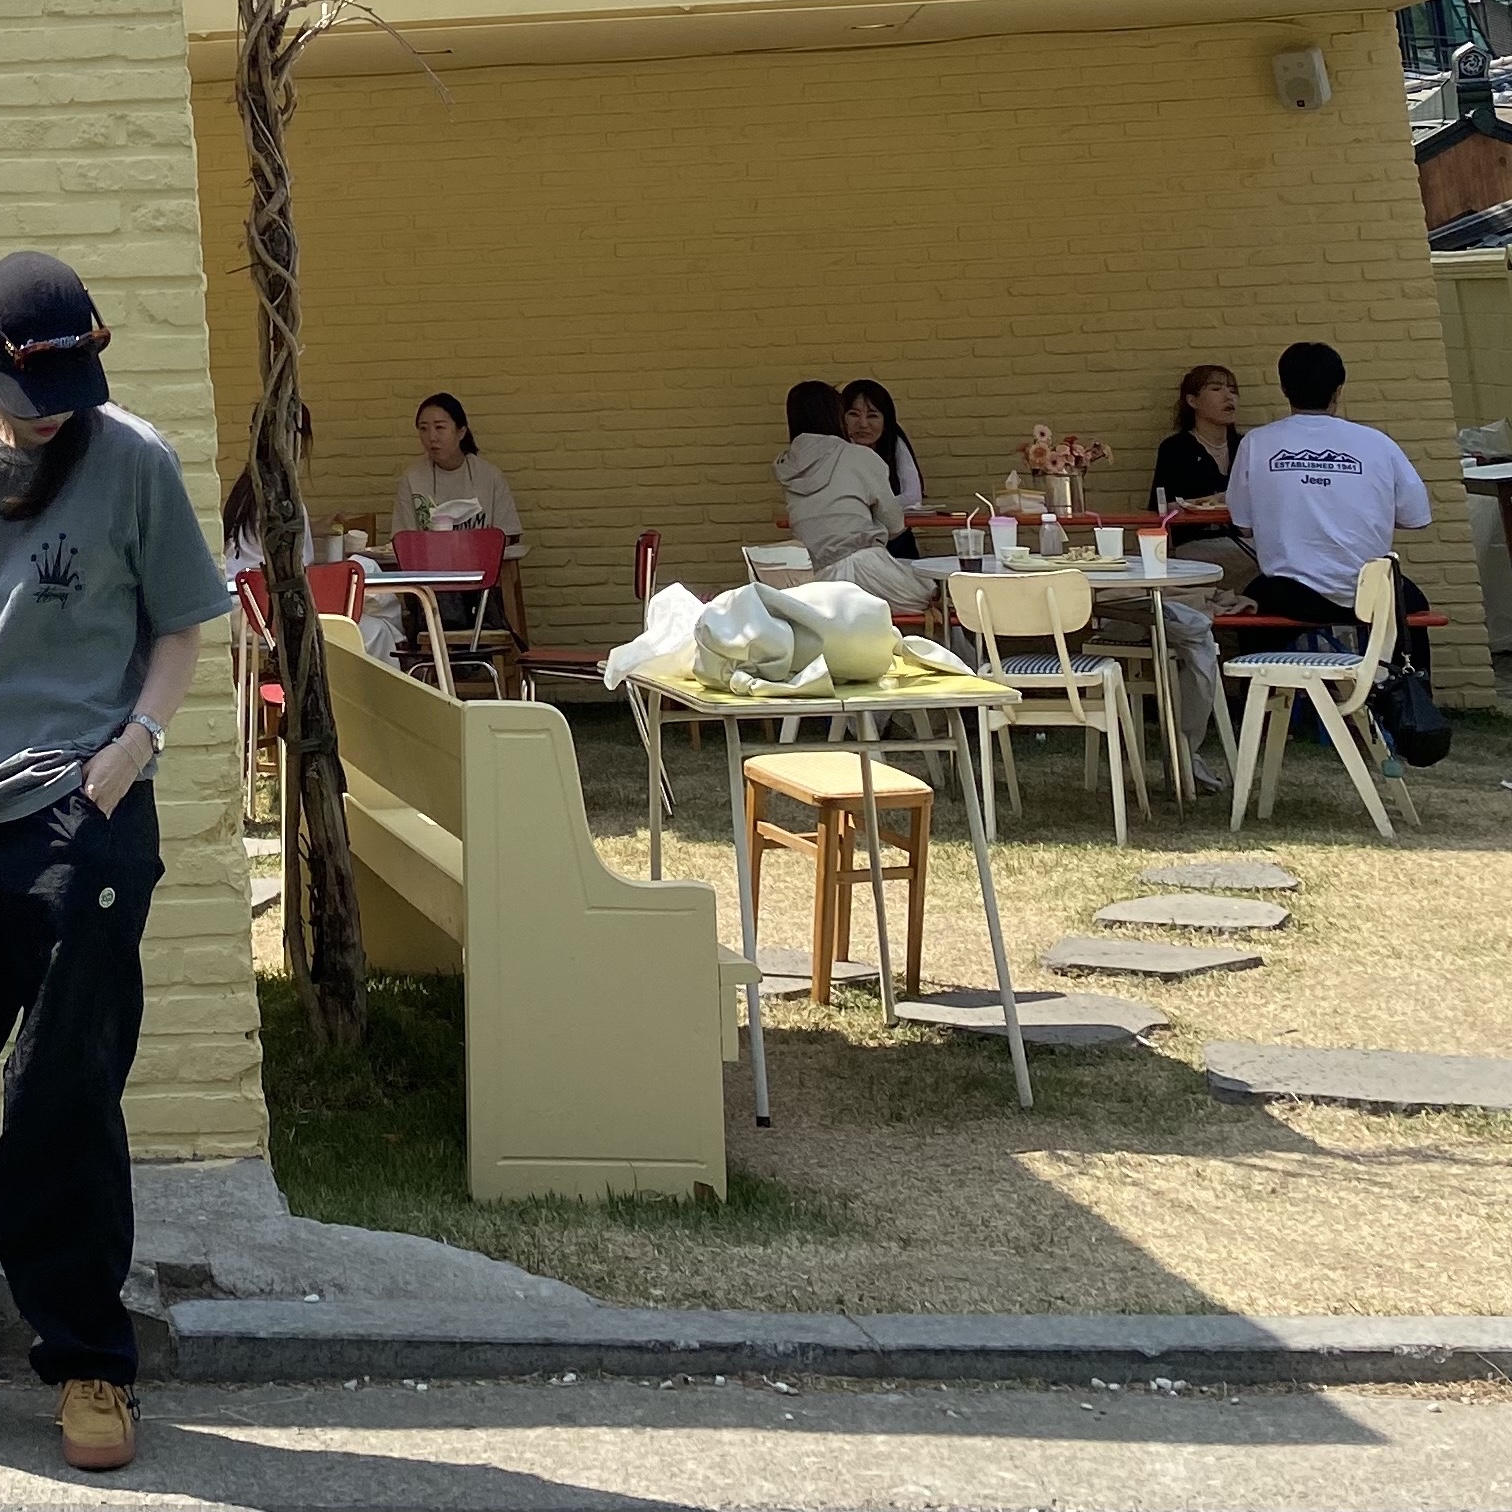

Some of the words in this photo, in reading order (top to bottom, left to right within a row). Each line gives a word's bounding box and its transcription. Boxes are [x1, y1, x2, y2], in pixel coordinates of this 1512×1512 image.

[1274, 461, 1335, 470] ESTABLISHED
[1337, 463, 1357, 471] 1941
[1300, 474, 1332, 487] Jeep
